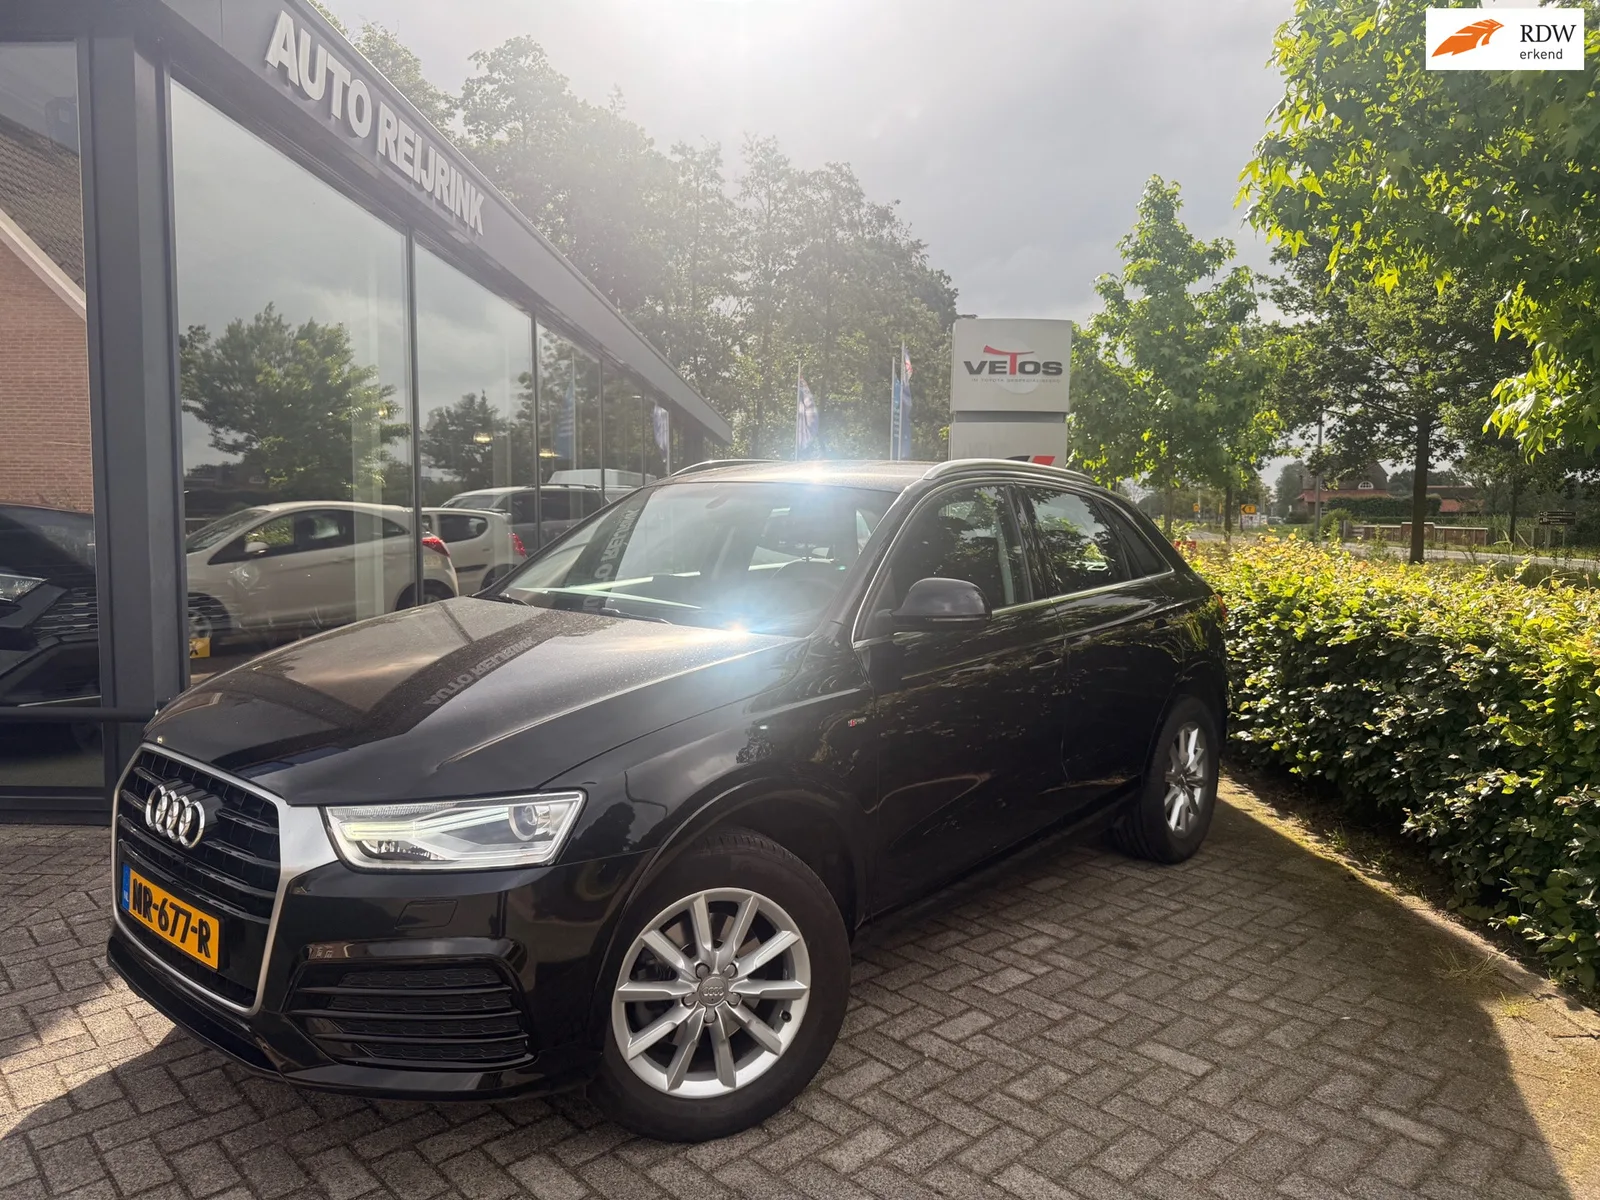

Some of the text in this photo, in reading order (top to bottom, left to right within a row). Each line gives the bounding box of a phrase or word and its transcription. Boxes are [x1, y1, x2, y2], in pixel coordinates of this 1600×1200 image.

[265, 10, 484, 236] AUTO REIJRINK
[963, 345, 1063, 376] VETOS
[133, 879, 211, 958] NR-677-R
